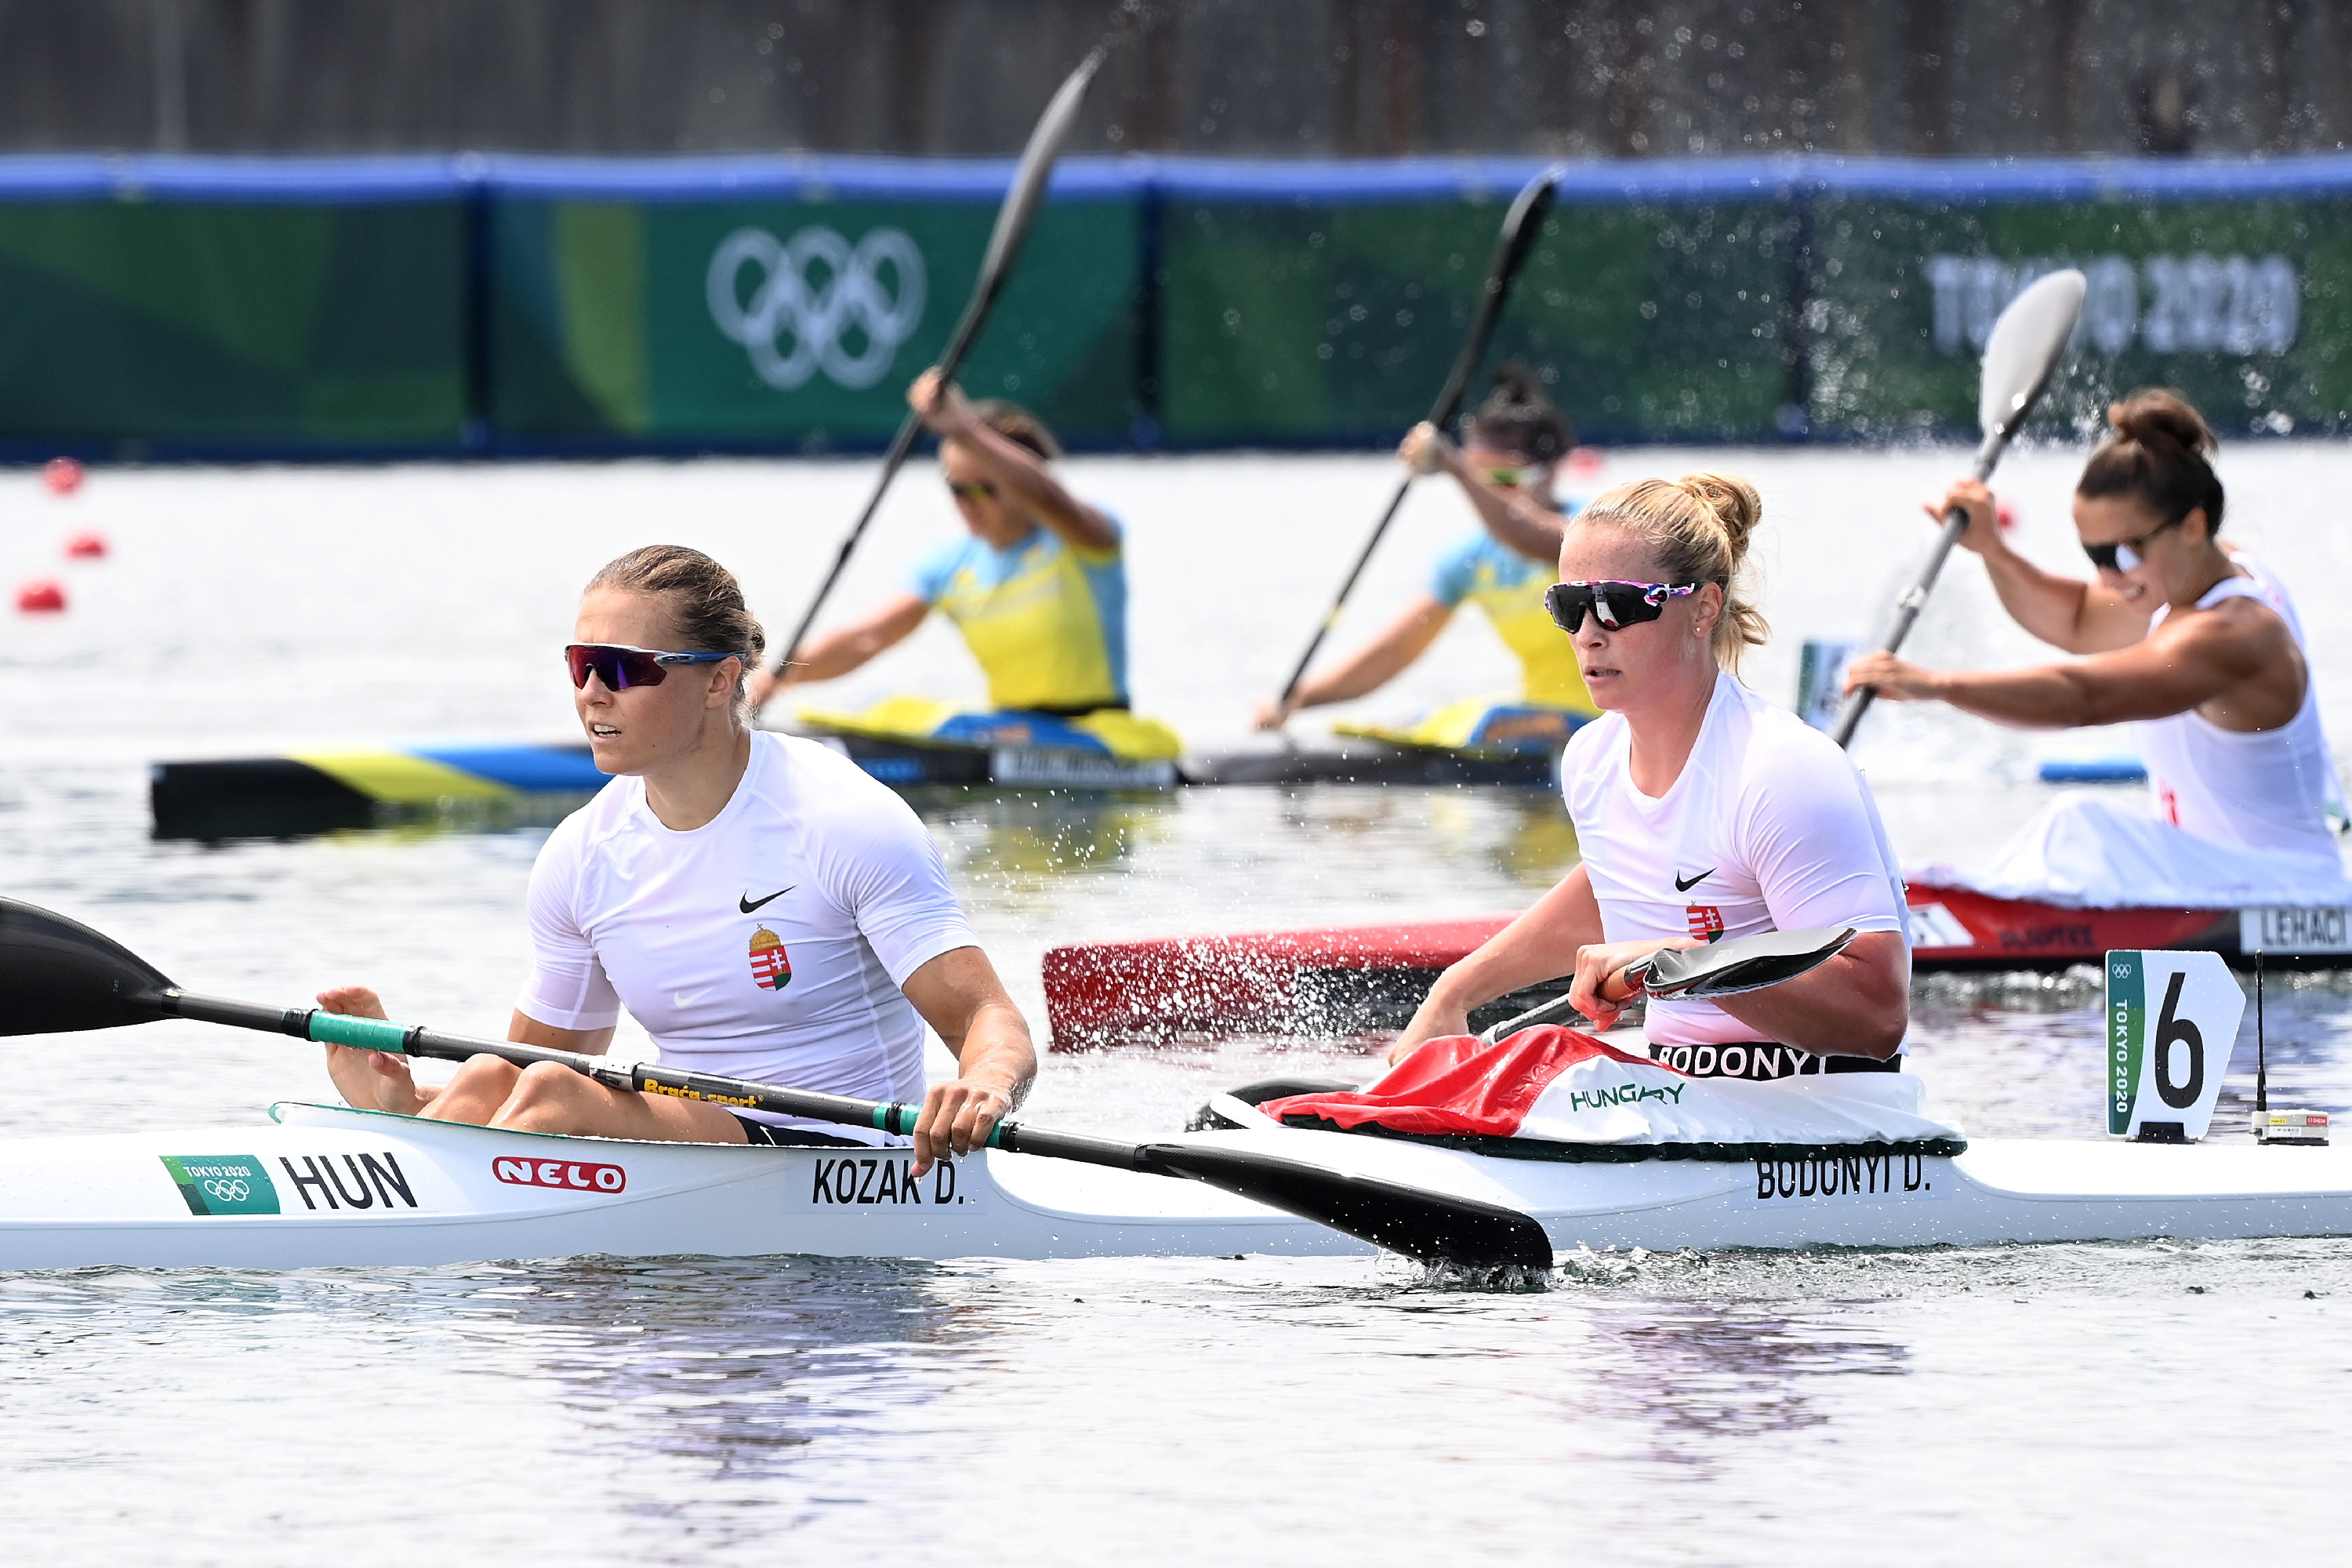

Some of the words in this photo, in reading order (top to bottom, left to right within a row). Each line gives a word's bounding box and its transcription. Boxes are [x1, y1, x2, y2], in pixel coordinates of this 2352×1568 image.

[2145, 252, 2299, 353] 2020
[2116, 999, 2128, 1062] TOKYO
[2154, 972, 2204, 1109] 6
[1570, 1083, 1686, 1112] HUNGARY
[2116, 1065, 2128, 1113] 2020
[183, 1166, 223, 1177] TOKYO
[222, 1165, 252, 1177] 2020
[278, 1152, 418, 1210] HUN
[498, 1160, 622, 1190] NELO
[812, 1159, 921, 1204] KOZAK
[935, 1159, 964, 1204] D.
[1756, 1155, 1890, 1200] BODONYI
[1904, 1153, 1930, 1192] D.
